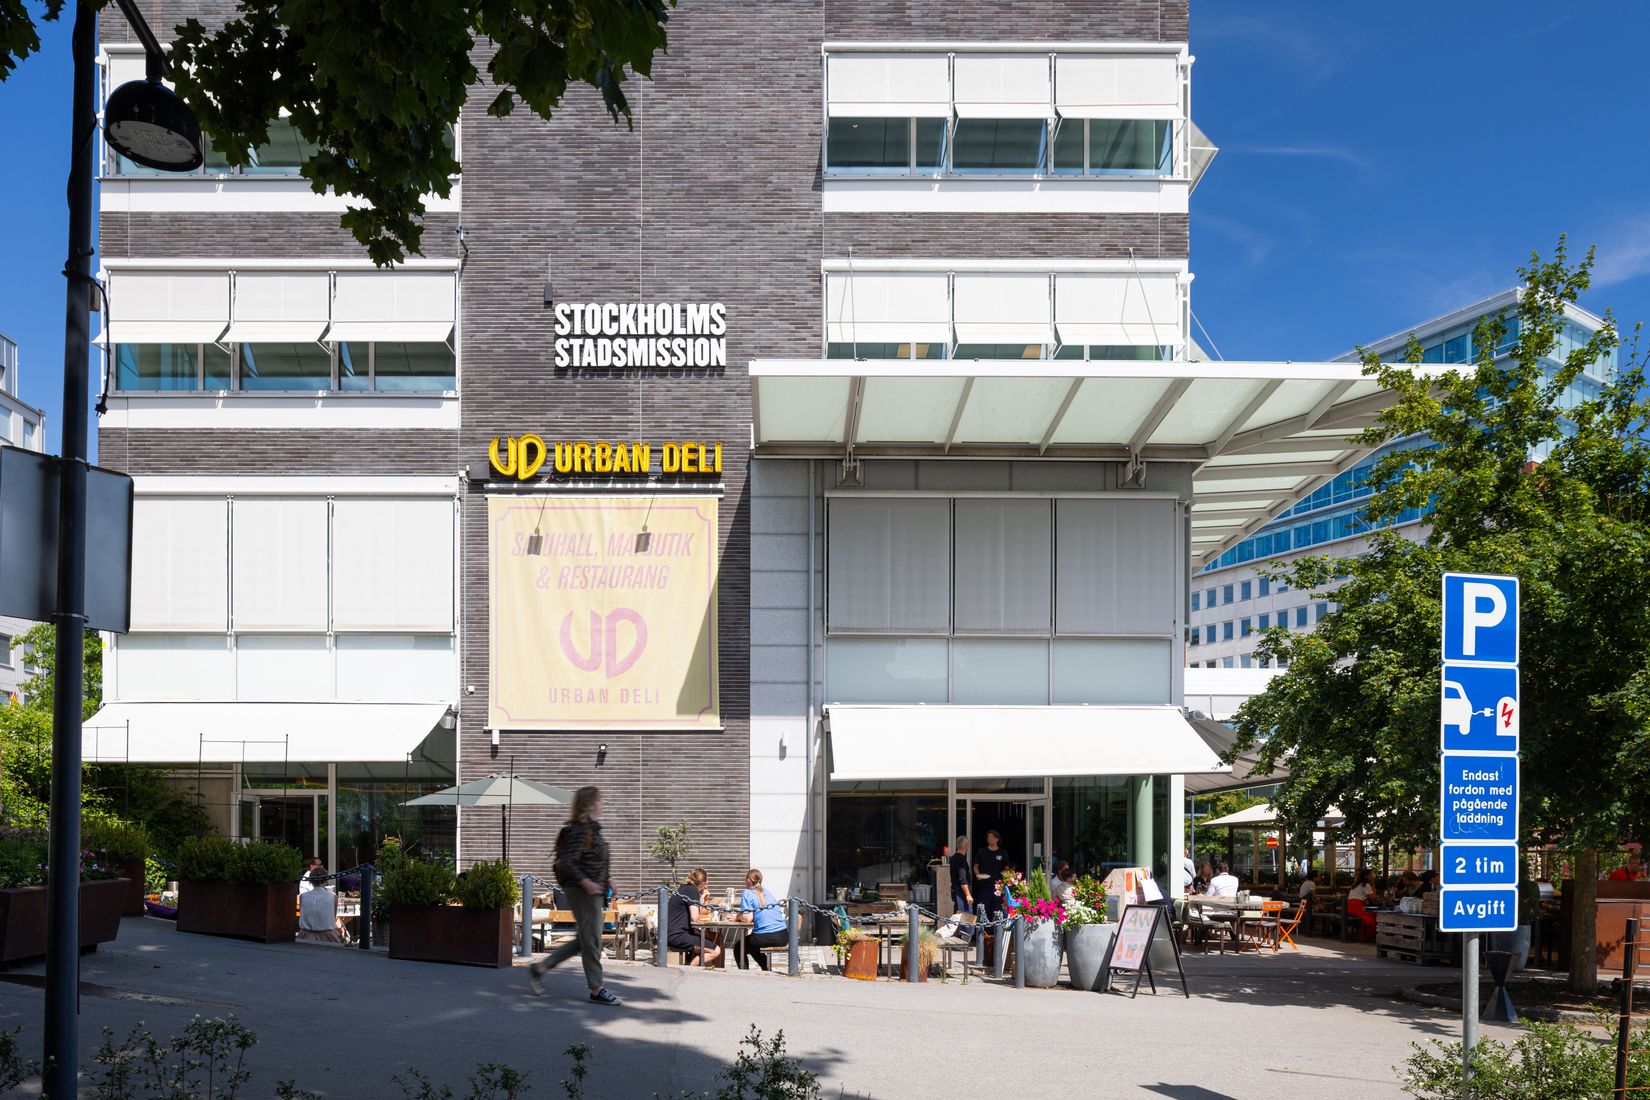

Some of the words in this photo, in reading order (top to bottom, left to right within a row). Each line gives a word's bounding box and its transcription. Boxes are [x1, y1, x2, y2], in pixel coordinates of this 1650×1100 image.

[554, 303, 726, 335] STOCKHOLMS
[554, 338, 726, 368] STADSMISSION
[489, 433, 547, 480] UD
[554, 441, 650, 473] URBAN
[662, 441, 722, 473] DELI
[536, 565, 550, 589] &
[557, 565, 670, 589] RESTAURANG
[1463, 582, 1507, 656] P
[559, 607, 648, 679] UD
[548, 688, 609, 704] URBAN
[620, 688, 659, 704] DELI
[1462, 769, 1499, 781] Endast
[1448, 783, 1485, 795] fordon
[1489, 784, 1513, 796] med
[1453, 798, 1508, 812] pågående
[1456, 812, 1504, 826] laddning
[1455, 857, 1467, 874] 2
[1475, 857, 1504, 874] tim
[1453, 900, 1505, 918] Avgift
